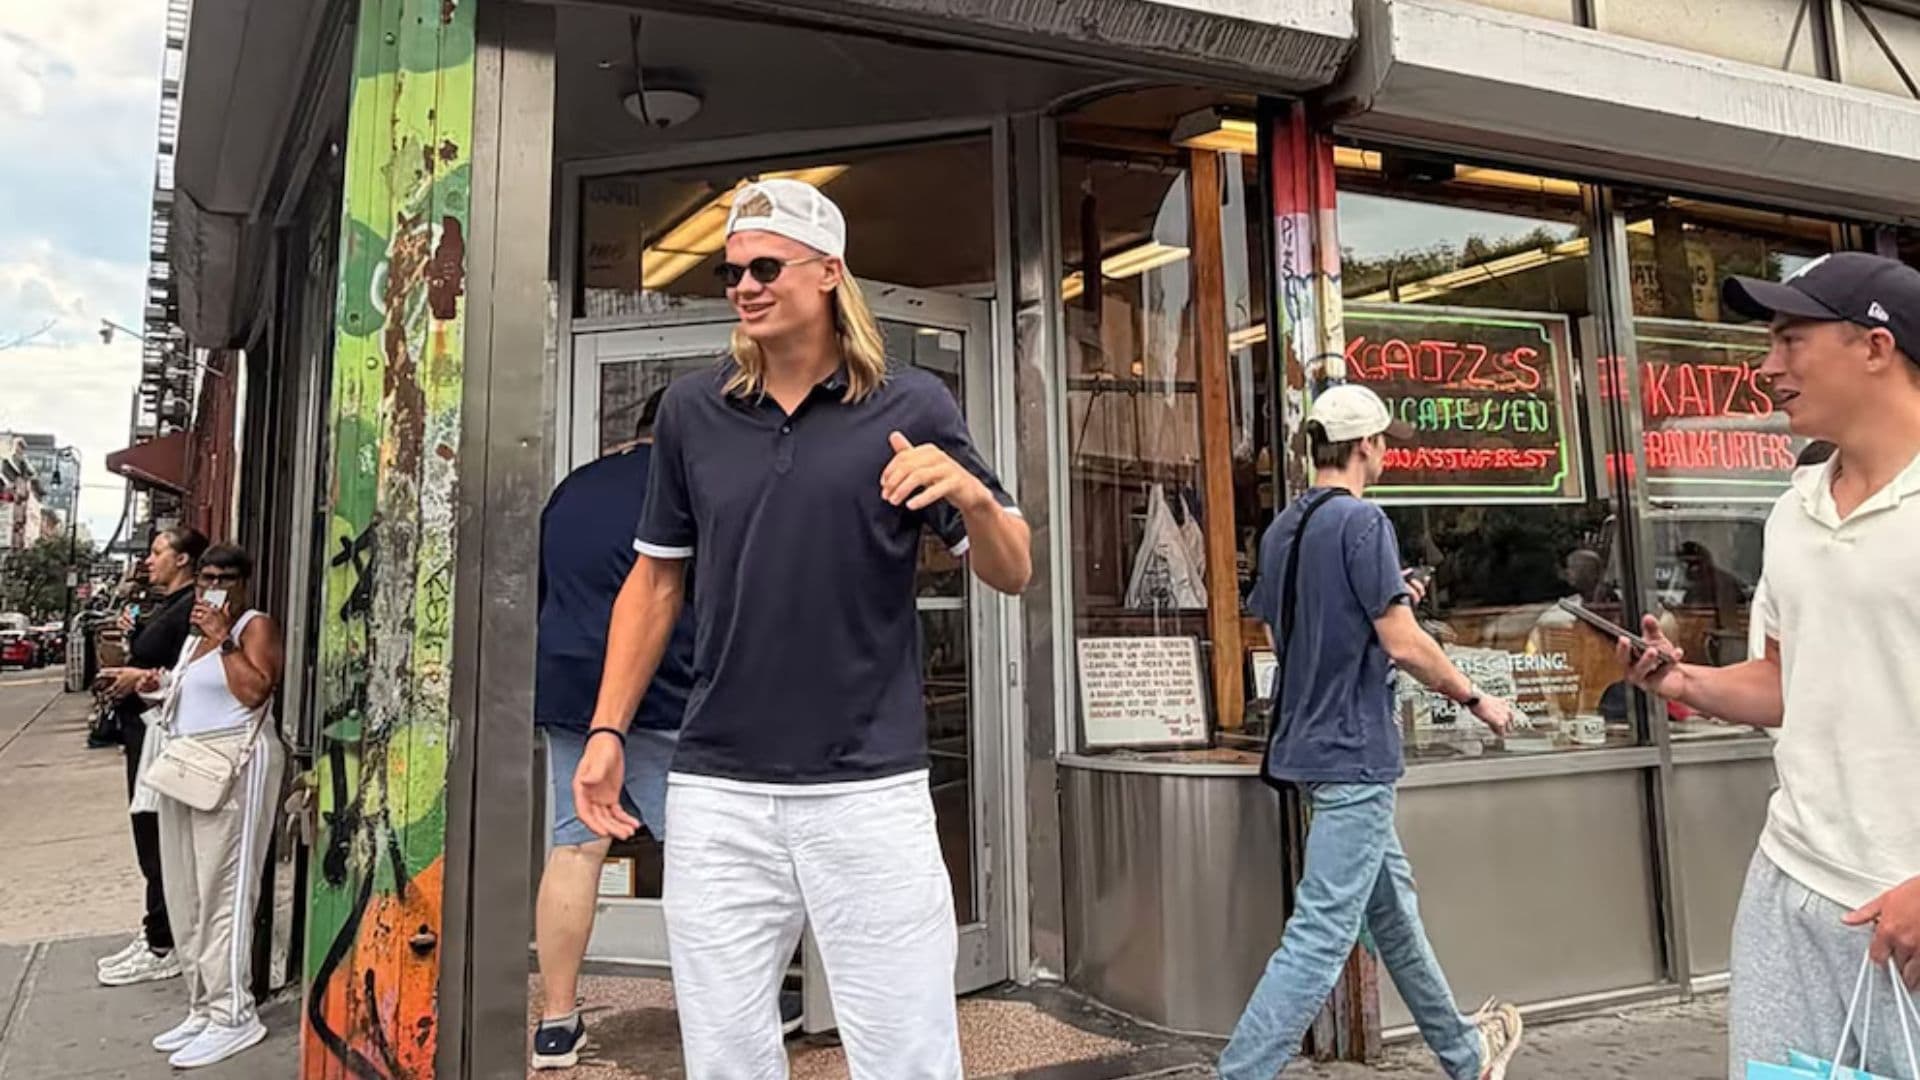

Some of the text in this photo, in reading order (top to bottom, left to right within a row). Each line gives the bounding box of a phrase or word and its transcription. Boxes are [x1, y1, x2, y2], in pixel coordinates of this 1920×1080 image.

[1646, 361, 1774, 417] KATZ'S
[1388, 396, 1549, 432] ICATESSEN
[1082, 641, 1110, 649] PLEASE
[1112, 641, 1141, 649] RETURN
